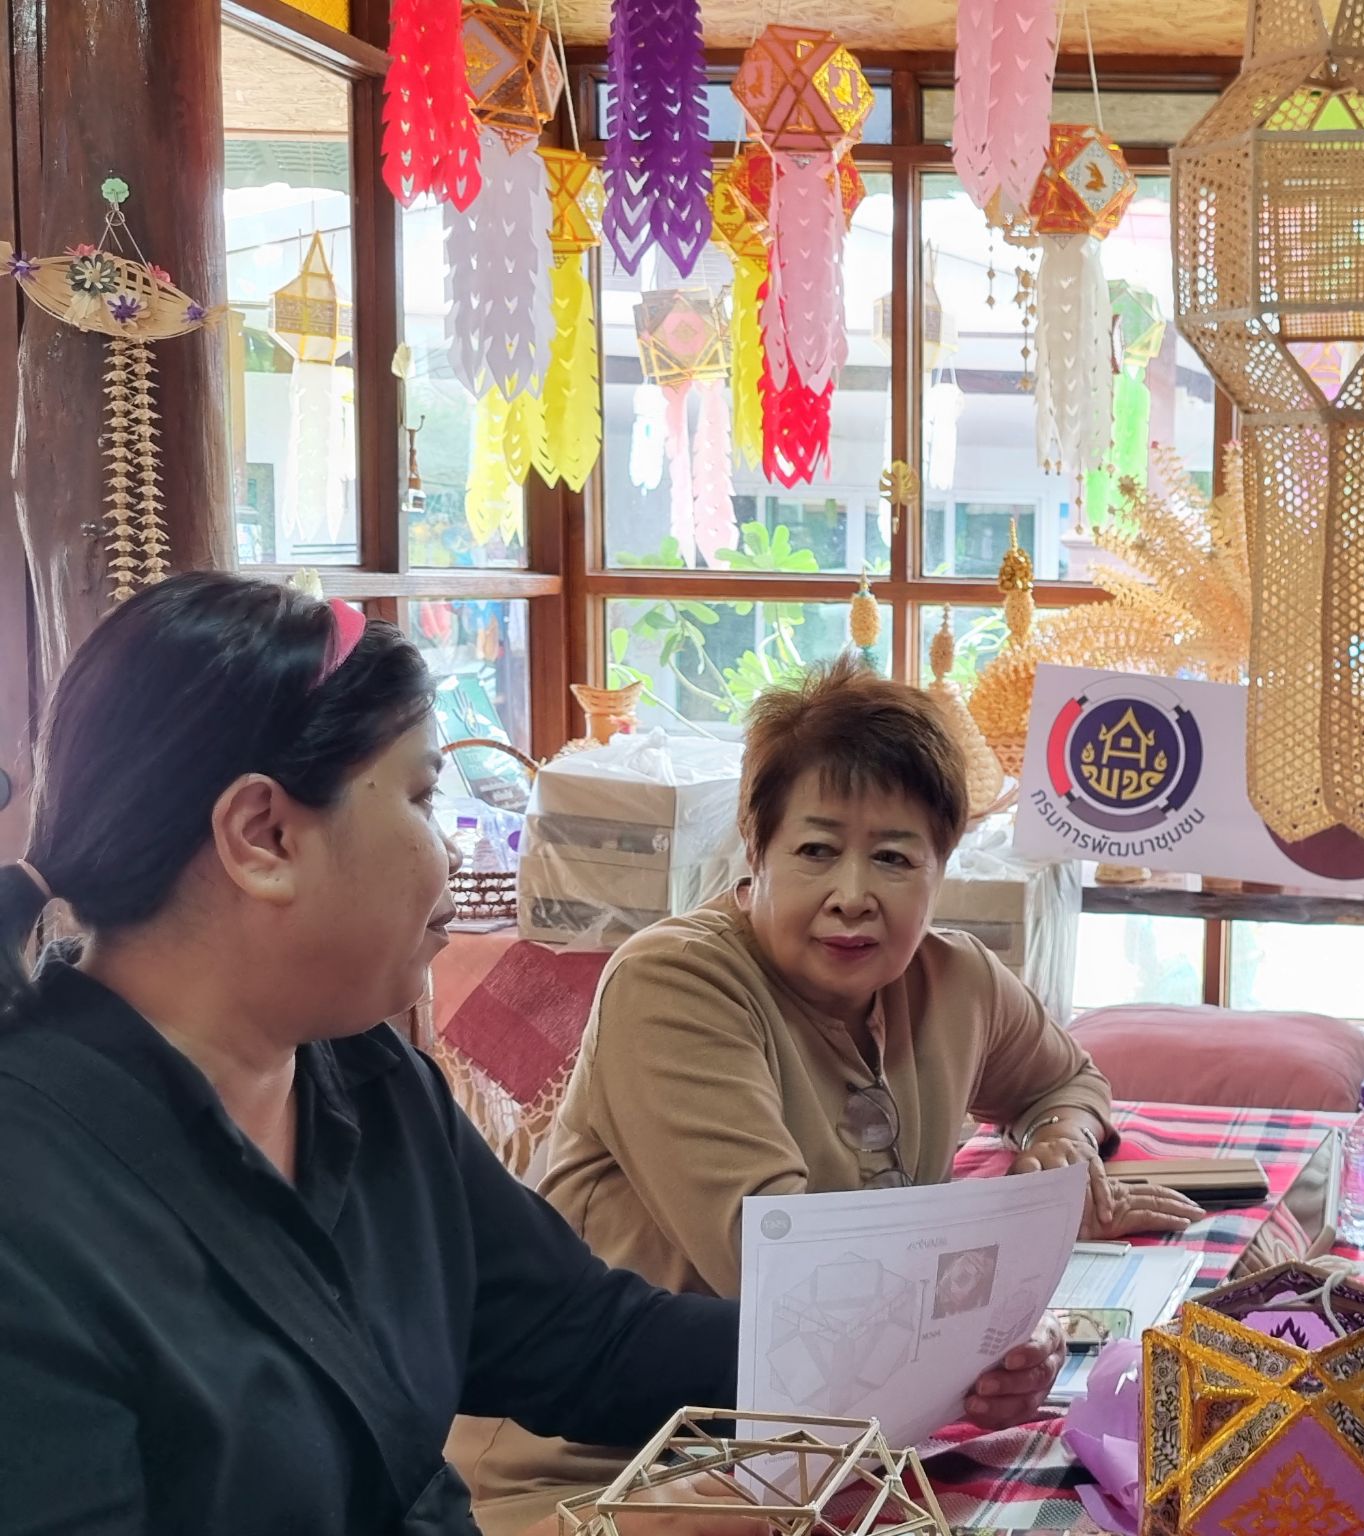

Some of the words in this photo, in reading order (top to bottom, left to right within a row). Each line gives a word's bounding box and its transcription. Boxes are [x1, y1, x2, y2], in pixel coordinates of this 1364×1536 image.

[1030, 788, 1206, 858] กรมการพัฒนาชุมชน
